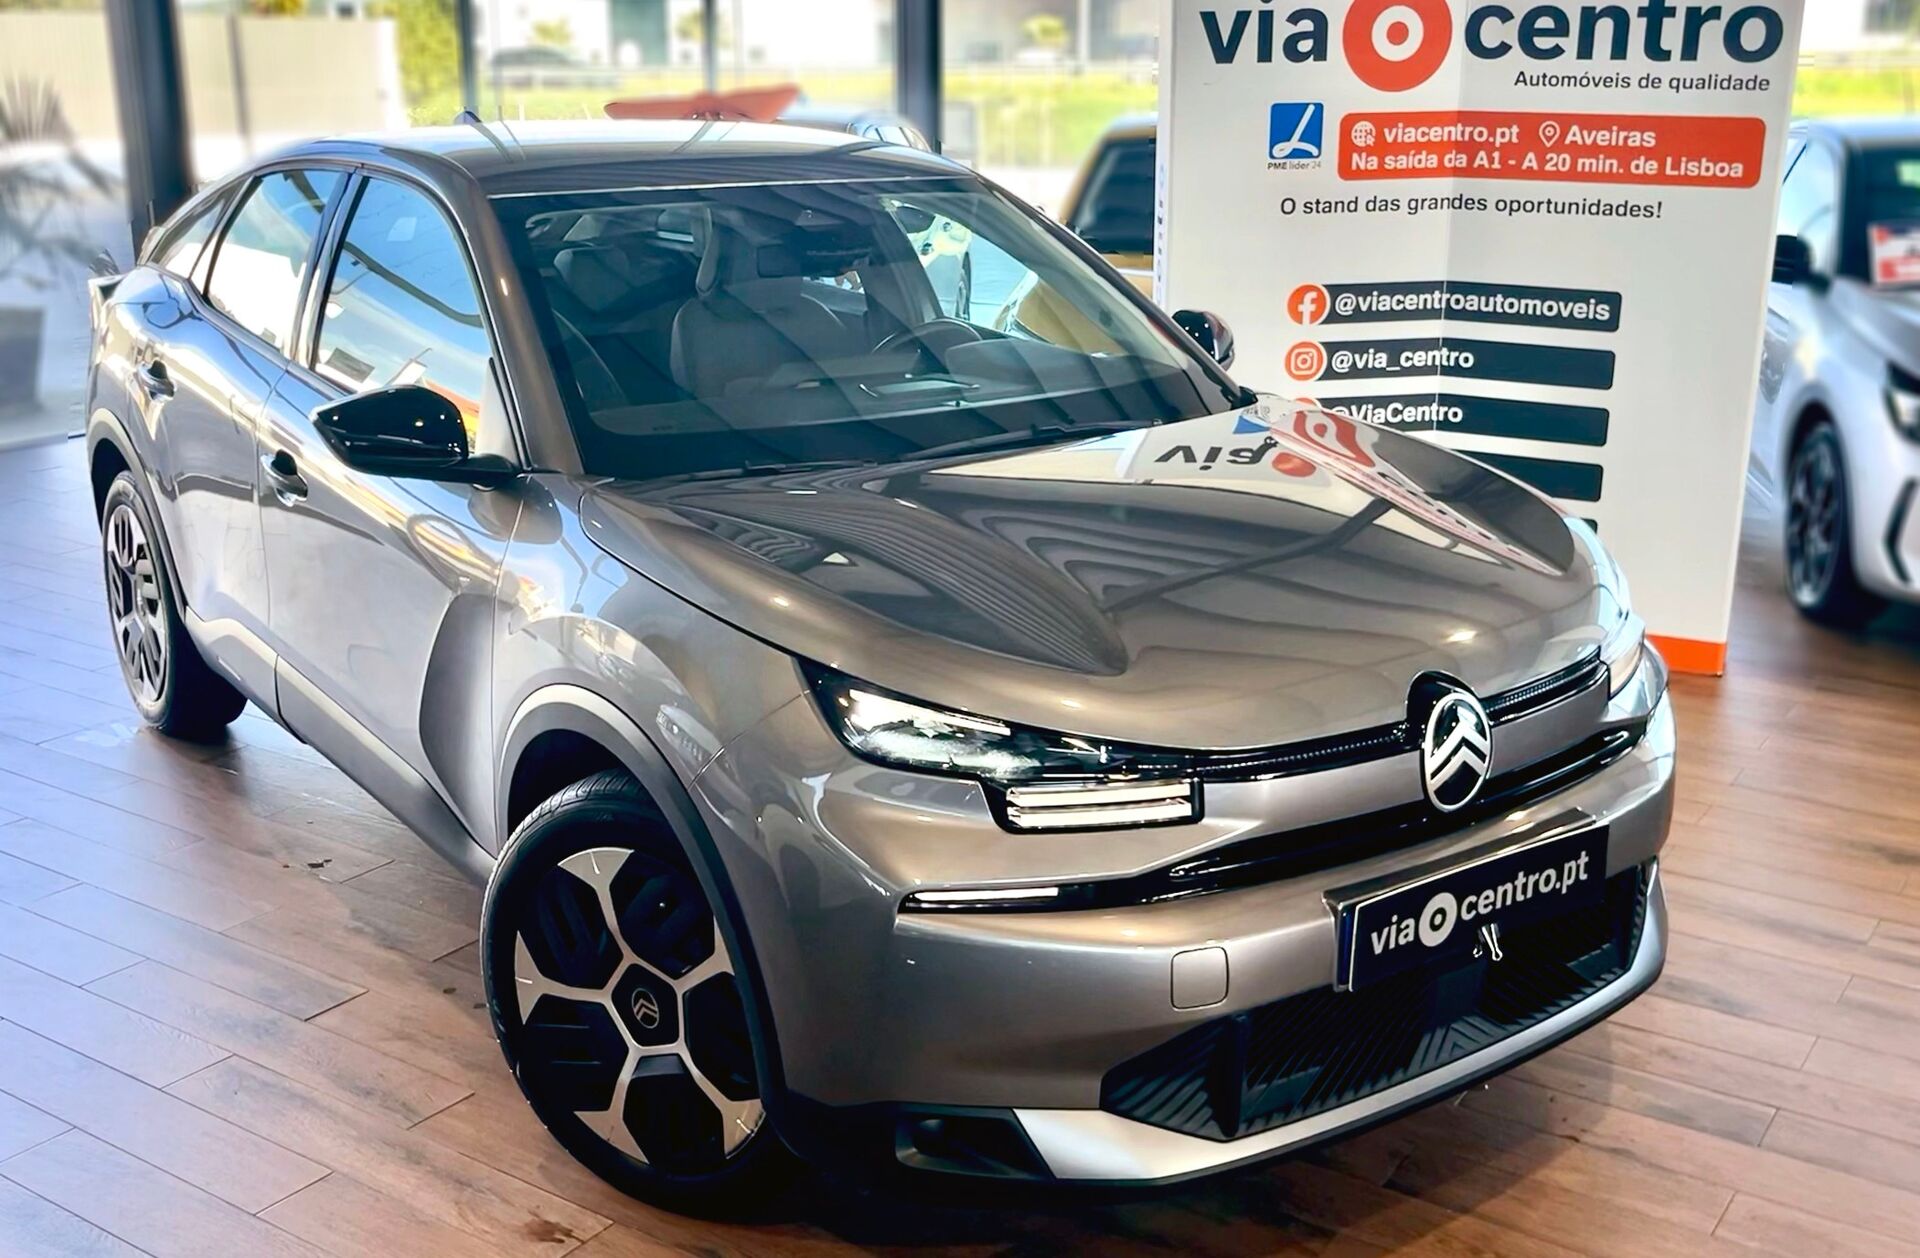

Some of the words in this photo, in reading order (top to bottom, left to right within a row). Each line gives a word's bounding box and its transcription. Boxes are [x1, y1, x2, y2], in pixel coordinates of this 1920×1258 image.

[1199, 0, 1328, 64] via
[1465, 0, 1784, 63] centro
[1514, 70, 1631, 90] Automóveis
[1638, 73, 1662, 90] de
[1669, 73, 1770, 93] qualidade
[1384, 123, 1520, 146] viacentro.pt
[1564, 125, 1657, 148] Aveiras
[1267, 161, 1287, 170] PME
[1351, 152, 1379, 171] Na
[1384, 150, 1438, 170] saída
[1444, 149, 1467, 169] da
[1474, 150, 1502, 169] A1
[1522, 152, 1539, 171] A
[1544, 153, 1572, 172] 20
[1577, 155, 1625, 175] min.
[1631, 156, 1659, 175] de
[1665, 157, 1744, 178] Lisboa
[1281, 198, 1296, 214] O
[1303, 196, 1359, 214] stand
[1365, 195, 1400, 212] das
[1407, 193, 1487, 214] grandes
[1495, 198, 1662, 218] oportunidades!
[1335, 291, 1610, 321] @viacentroautomoveis
[1331, 347, 1474, 373] @via_centro
[1371, 914, 1414, 955] via
[1461, 850, 1589, 921] centro.pt
